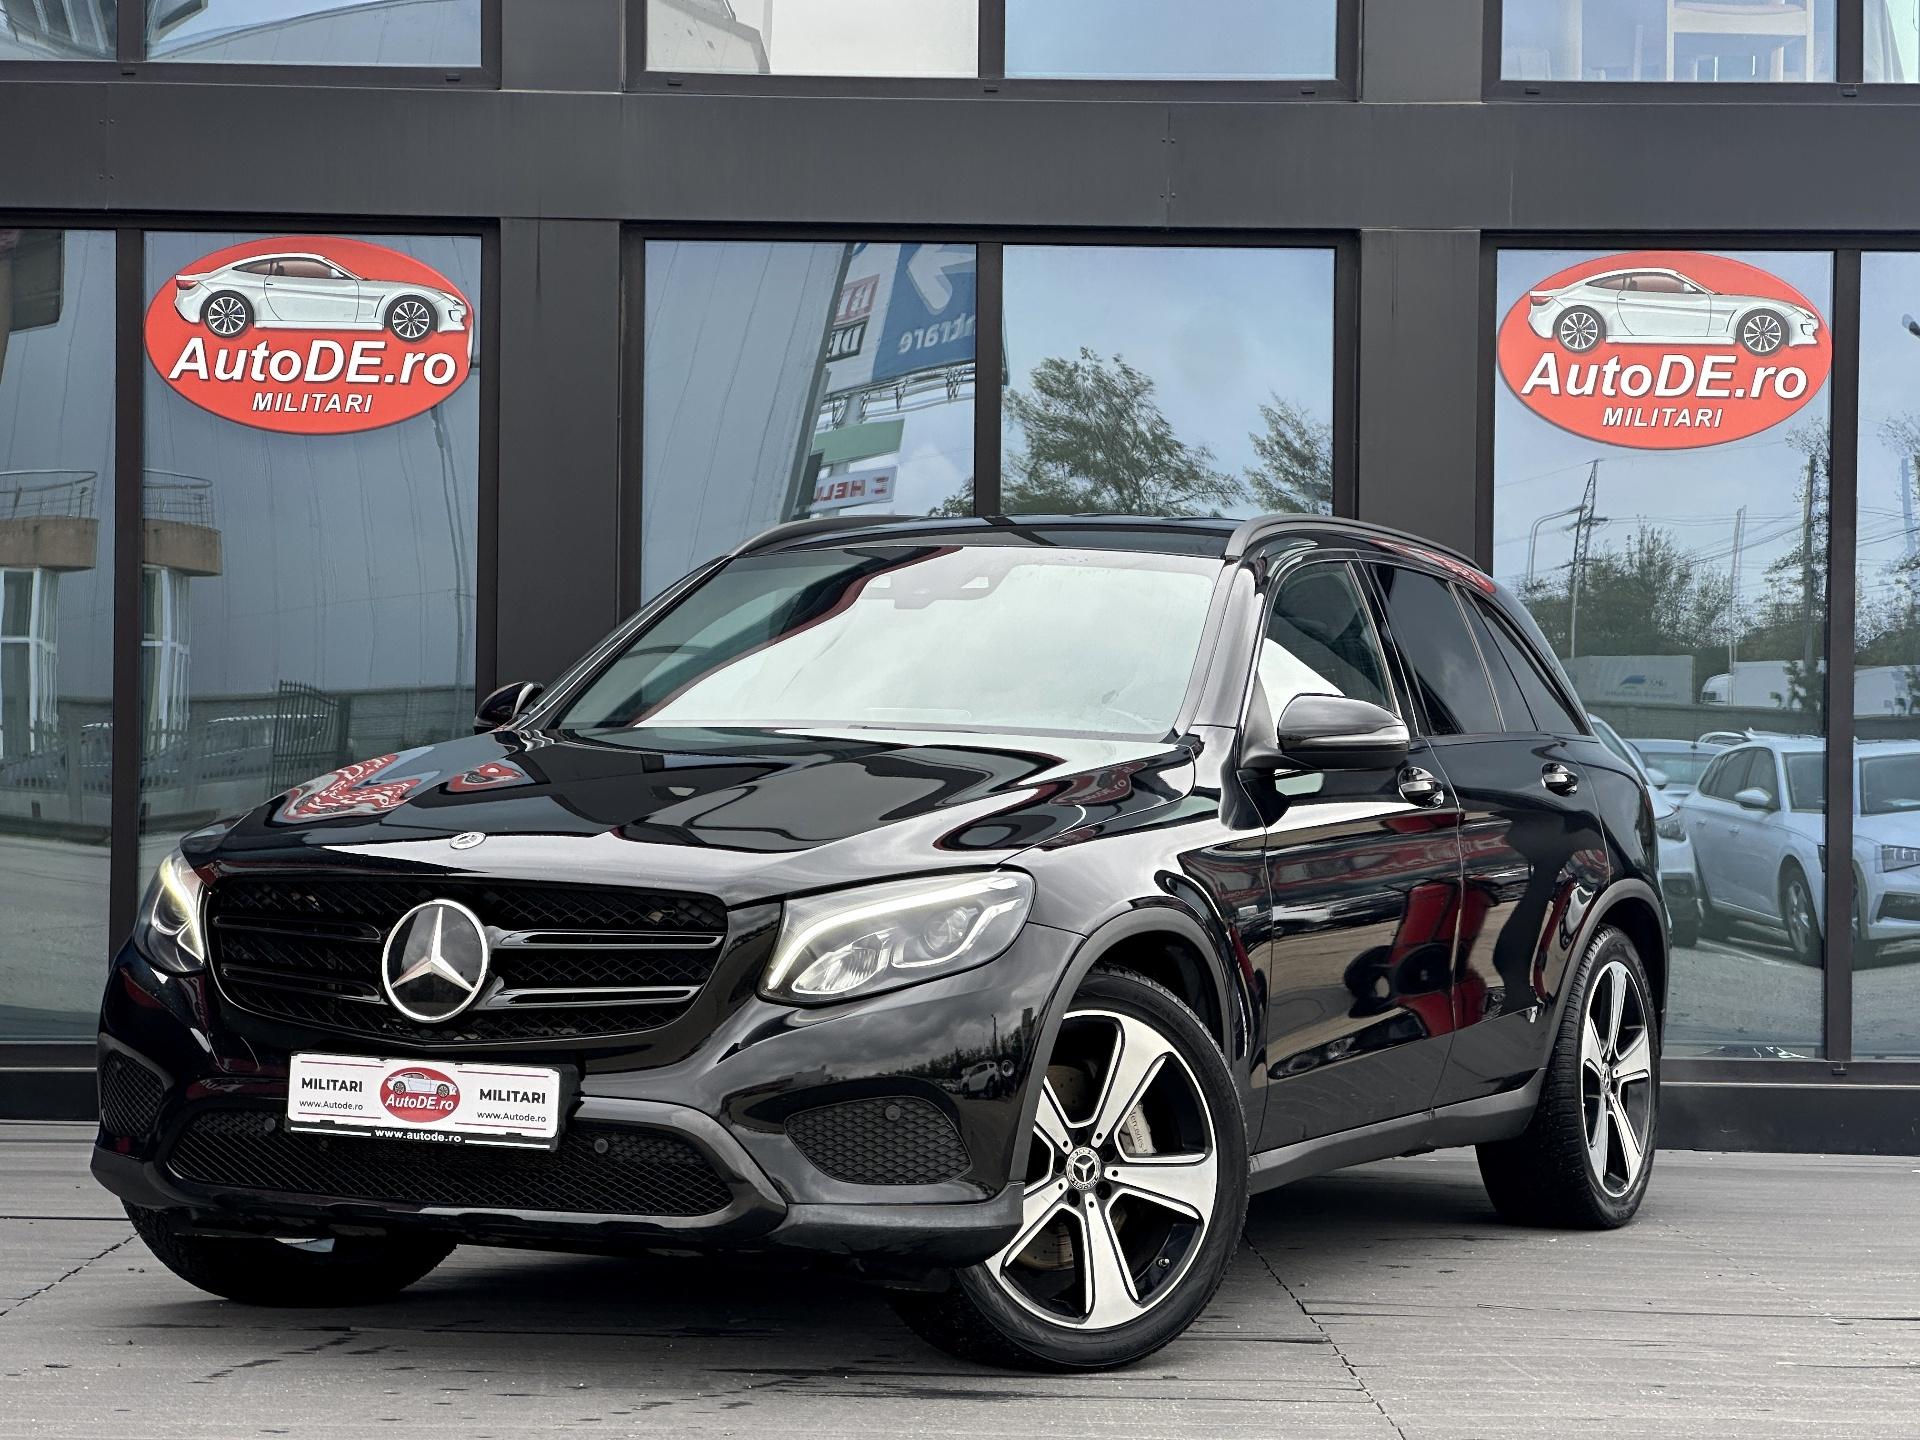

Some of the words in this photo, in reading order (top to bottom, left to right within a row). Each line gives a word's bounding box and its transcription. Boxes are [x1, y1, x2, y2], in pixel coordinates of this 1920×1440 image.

[168, 337, 457, 386] AutoDE.ro
[1521, 351, 1808, 400] AutoDE.ro
[251, 392, 373, 414] MILITARI
[1602, 406, 1723, 428] MILITARI
[301, 1077, 363, 1093] MILITARI
[385, 1094, 455, 1111] AutoDE.ro
[479, 1088, 546, 1104] MILITARI
[299, 1099, 364, 1111] www.Autode.ro
[477, 1110, 547, 1123] www.Autode.ro
[374, 1128, 462, 1143] www.autode.ro
